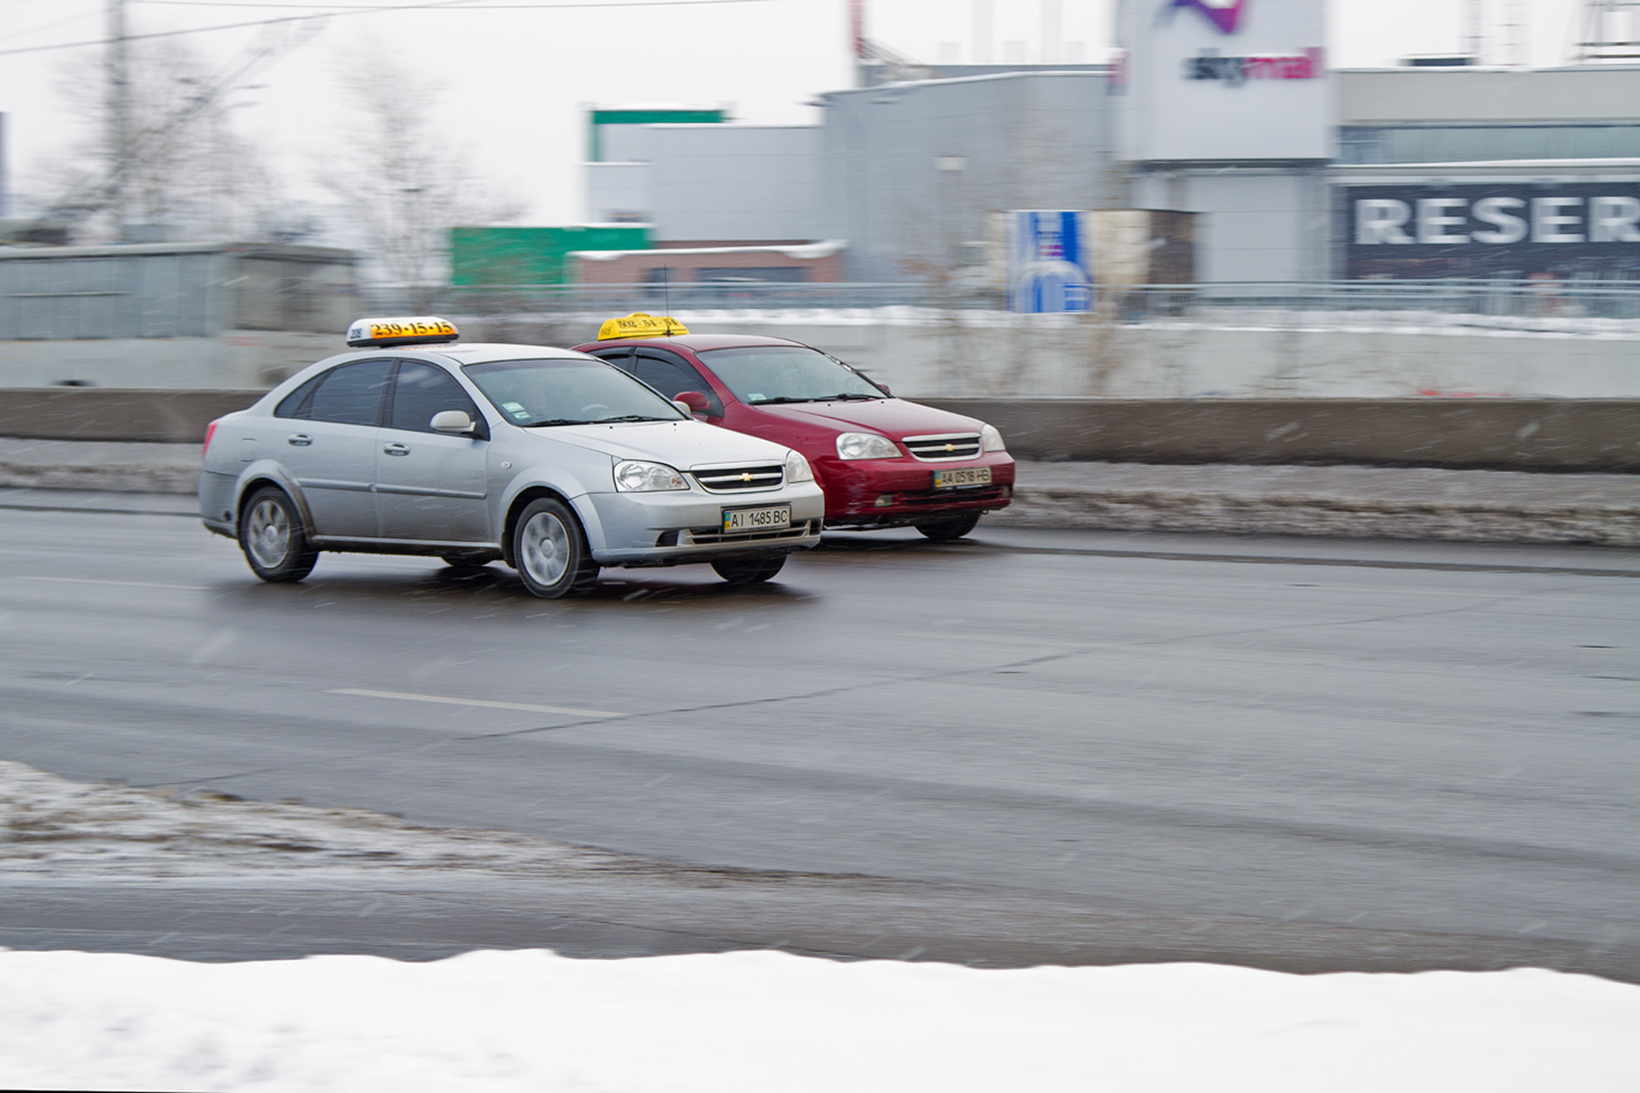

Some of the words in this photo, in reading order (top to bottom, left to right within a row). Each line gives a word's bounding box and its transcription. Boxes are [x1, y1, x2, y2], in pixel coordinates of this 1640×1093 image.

[1355, 196, 1640, 245] RESER
[731, 513, 744, 528] AI
[749, 510, 772, 526] 1485
[773, 509, 788, 524] BC
